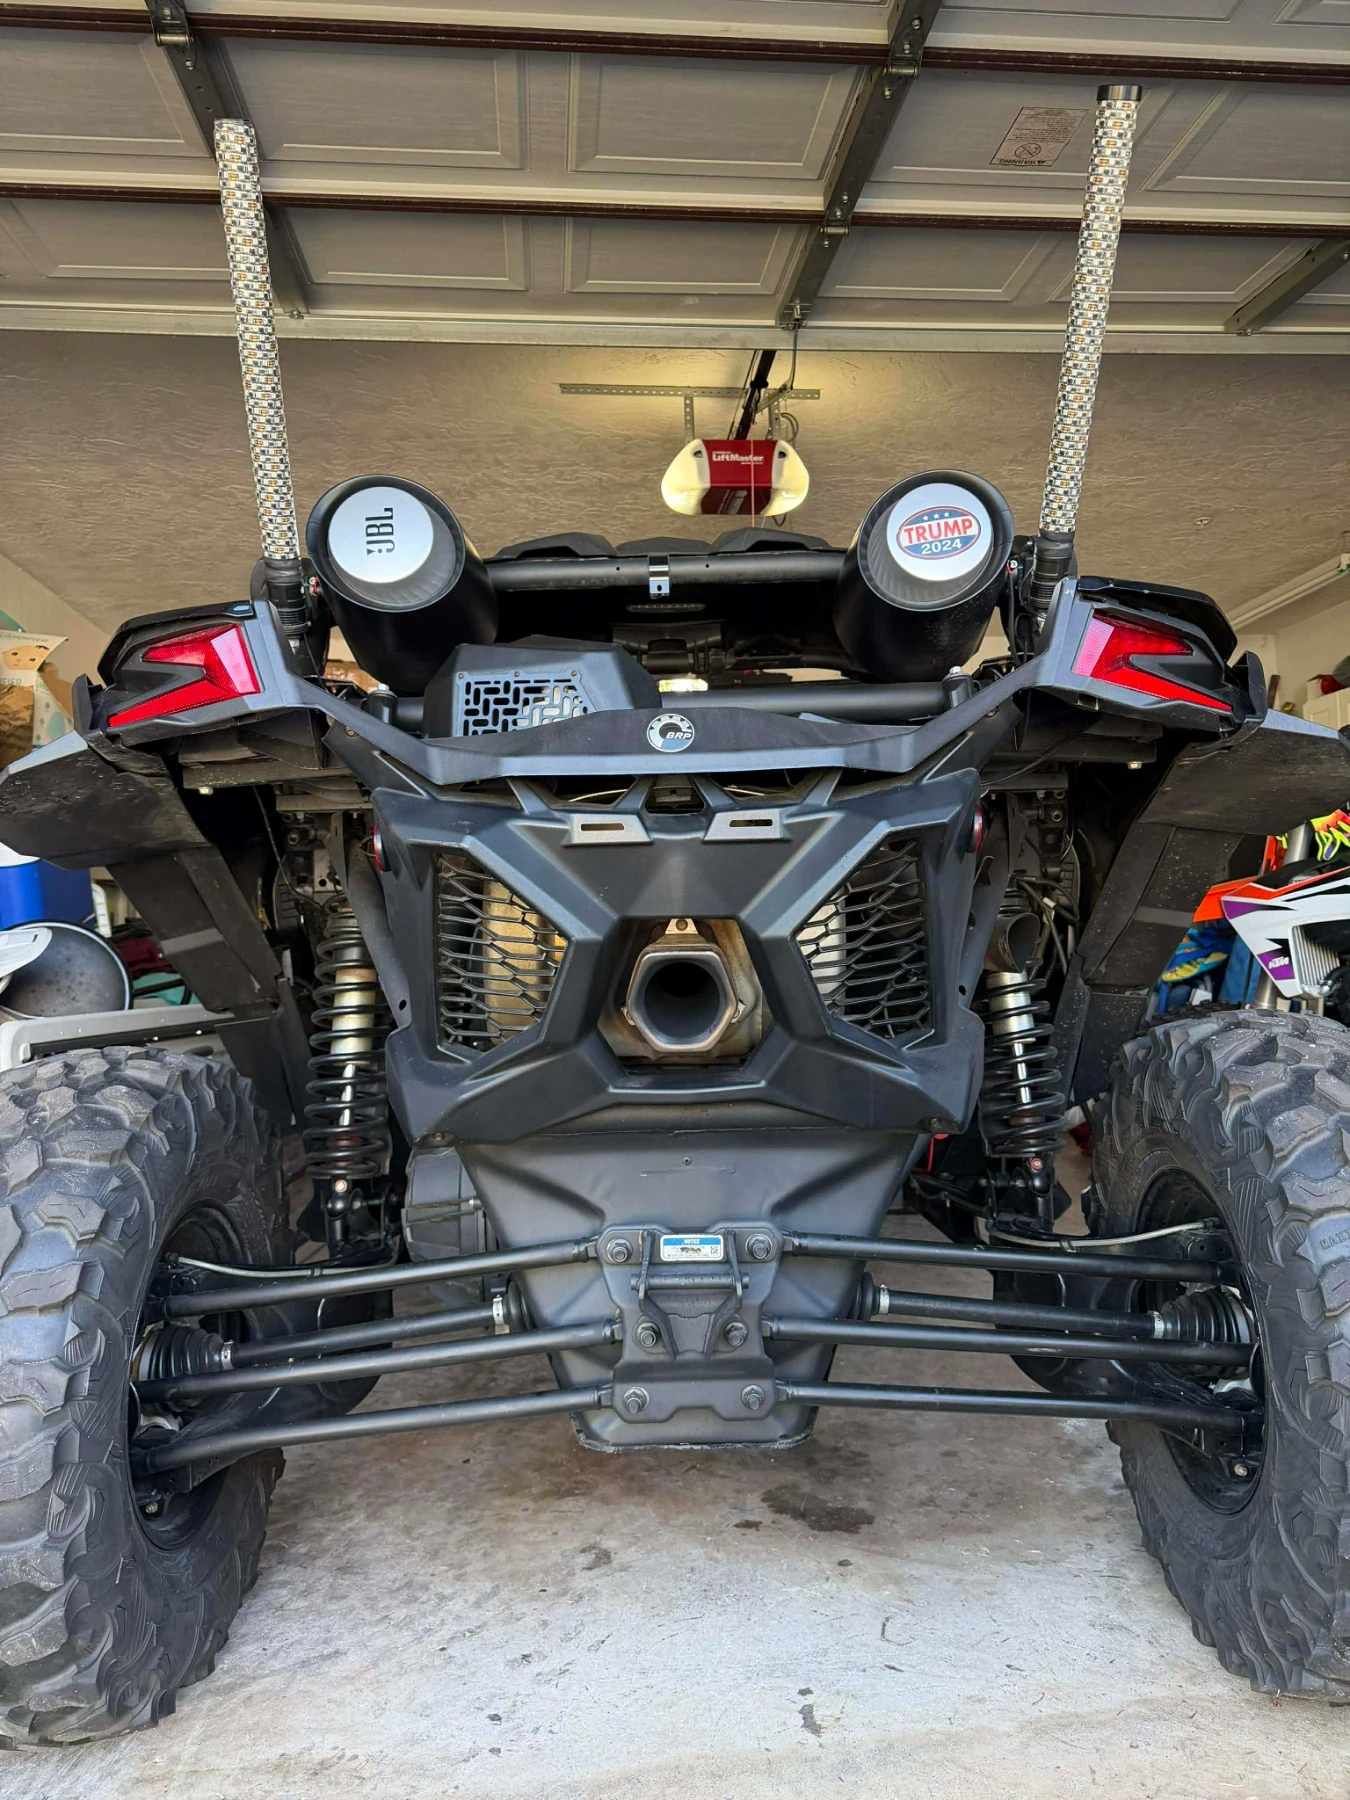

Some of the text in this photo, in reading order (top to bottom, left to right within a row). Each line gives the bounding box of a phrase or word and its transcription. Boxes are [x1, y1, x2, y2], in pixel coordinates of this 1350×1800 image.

[712, 453, 764, 462] LiftMaster
[365, 507, 395, 555] JBL
[904, 518, 973, 544] TRUMP
[921, 538, 962, 555] 2024
[666, 731, 692, 739] BRP
[1268, 956, 1290, 969] KTM
